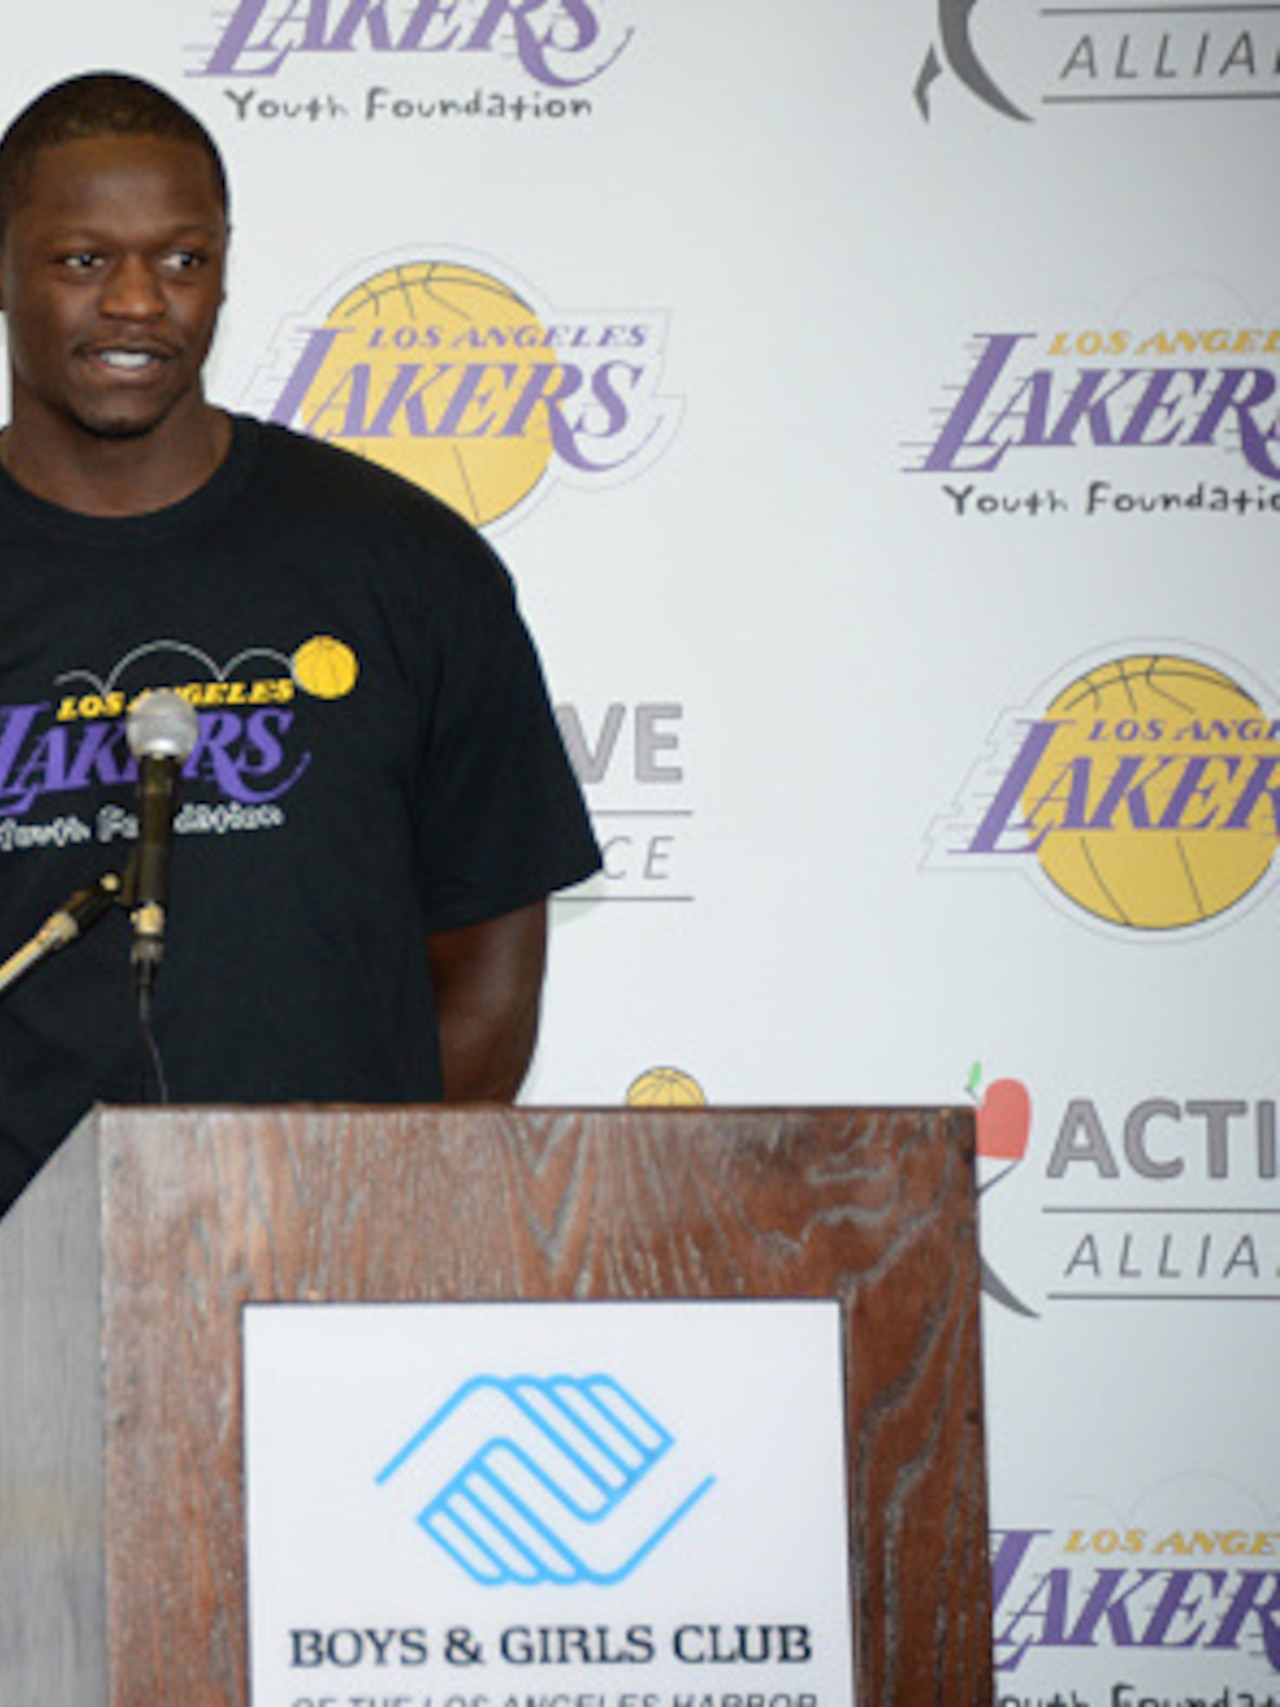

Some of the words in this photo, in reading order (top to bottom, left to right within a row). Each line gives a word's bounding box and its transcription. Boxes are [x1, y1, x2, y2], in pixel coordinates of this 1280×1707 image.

[1058, 30, 1280, 80] ALLIA
[223, 88, 348, 121] Youth
[364, 86, 593, 122] Foundation
[366, 324, 442, 350] LOS
[450, 323, 650, 351] ANGELES
[1045, 328, 1129, 357] LOS
[260, 326, 665, 473] LAKERS
[901, 332, 1280, 482] LAKER
[941, 484, 1068, 516] Youth
[56, 690, 127, 722] LOS
[1086, 717, 1166, 743] LOS
[1046, 1098, 1277, 1181] ACTI
[1063, 1232, 1280, 1280] ALLIA
[1063, 1529, 1147, 1557] LOS
[287, 1626, 429, 1669] BOYS
[442, 1624, 488, 1668] &
[498, 1624, 656, 1666] GIRLS
[672, 1624, 814, 1665] CLUB
